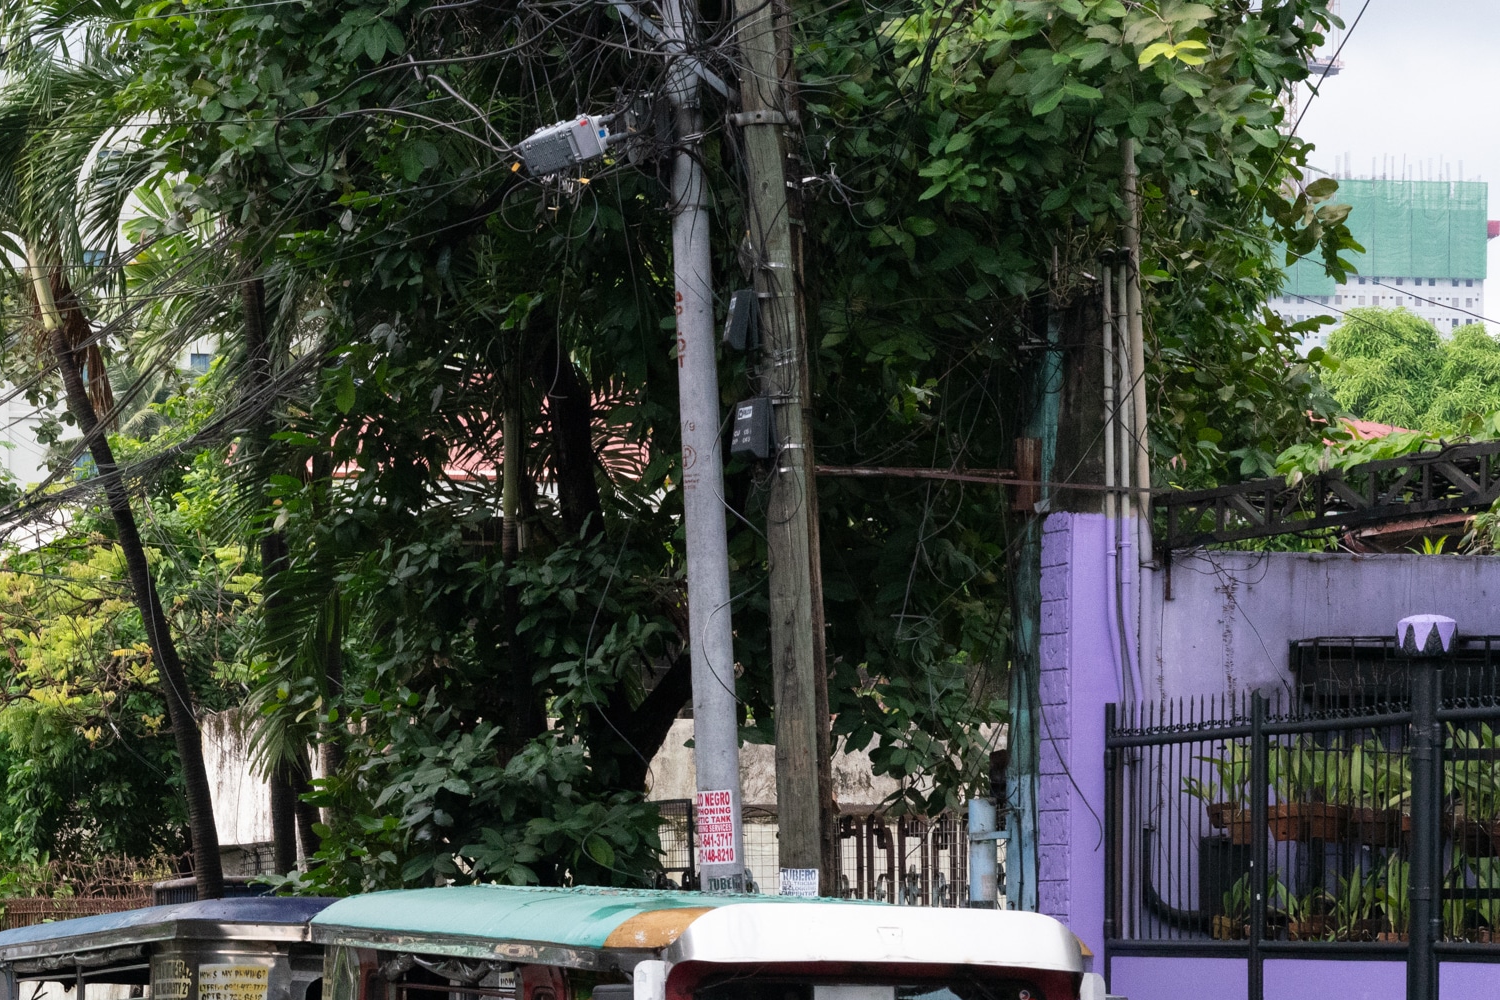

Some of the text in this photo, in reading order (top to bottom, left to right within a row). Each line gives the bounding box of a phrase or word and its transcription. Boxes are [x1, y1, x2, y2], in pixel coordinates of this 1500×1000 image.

[705, 792, 730, 806] NEGRO
[709, 823, 732, 832] SERVICES
[782, 868, 816, 881] TUBERO
